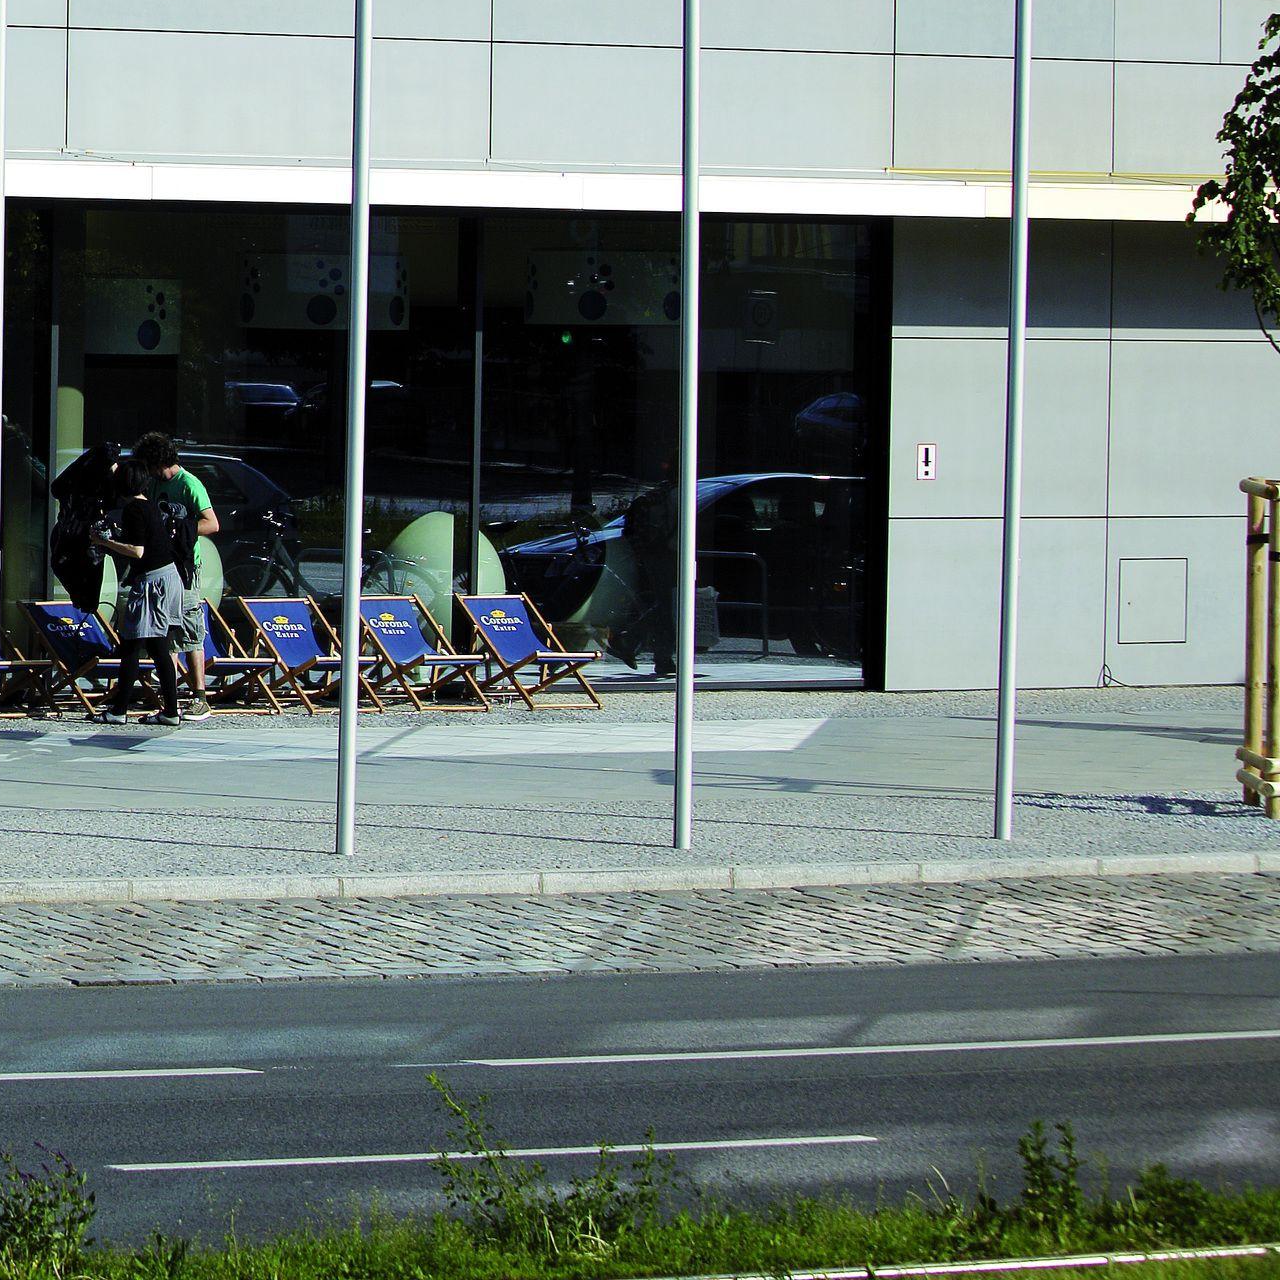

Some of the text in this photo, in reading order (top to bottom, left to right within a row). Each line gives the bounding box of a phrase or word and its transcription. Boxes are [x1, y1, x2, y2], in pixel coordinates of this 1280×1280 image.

[262, 621, 307, 631] Corona
[369, 618, 412, 629] Corona
[480, 615, 524, 626] Corona
